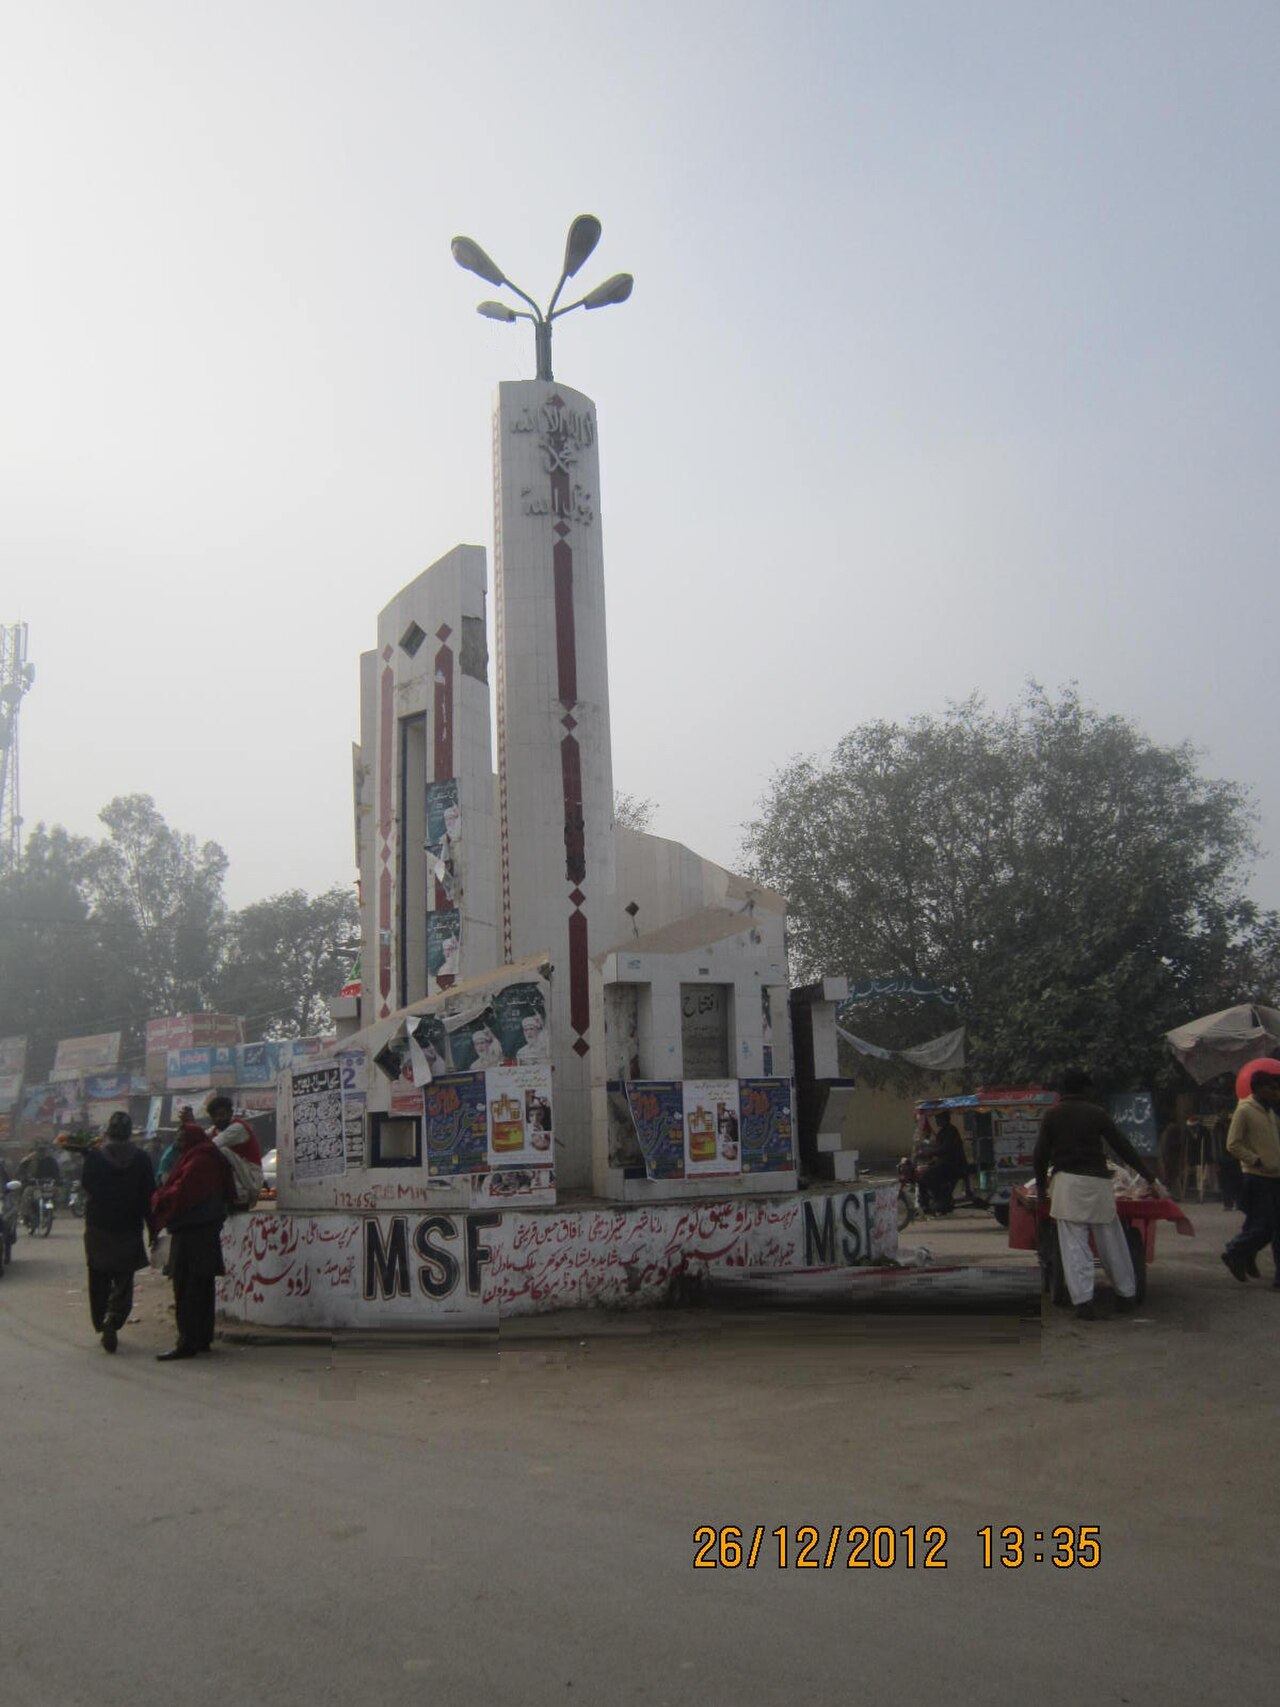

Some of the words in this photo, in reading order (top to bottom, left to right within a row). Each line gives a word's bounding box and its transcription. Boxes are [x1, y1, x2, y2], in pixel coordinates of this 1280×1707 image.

[681, 993, 720, 1018] افتتاح
[362, 1213, 503, 1301] MSF
[803, 1193, 876, 1266] MSF
